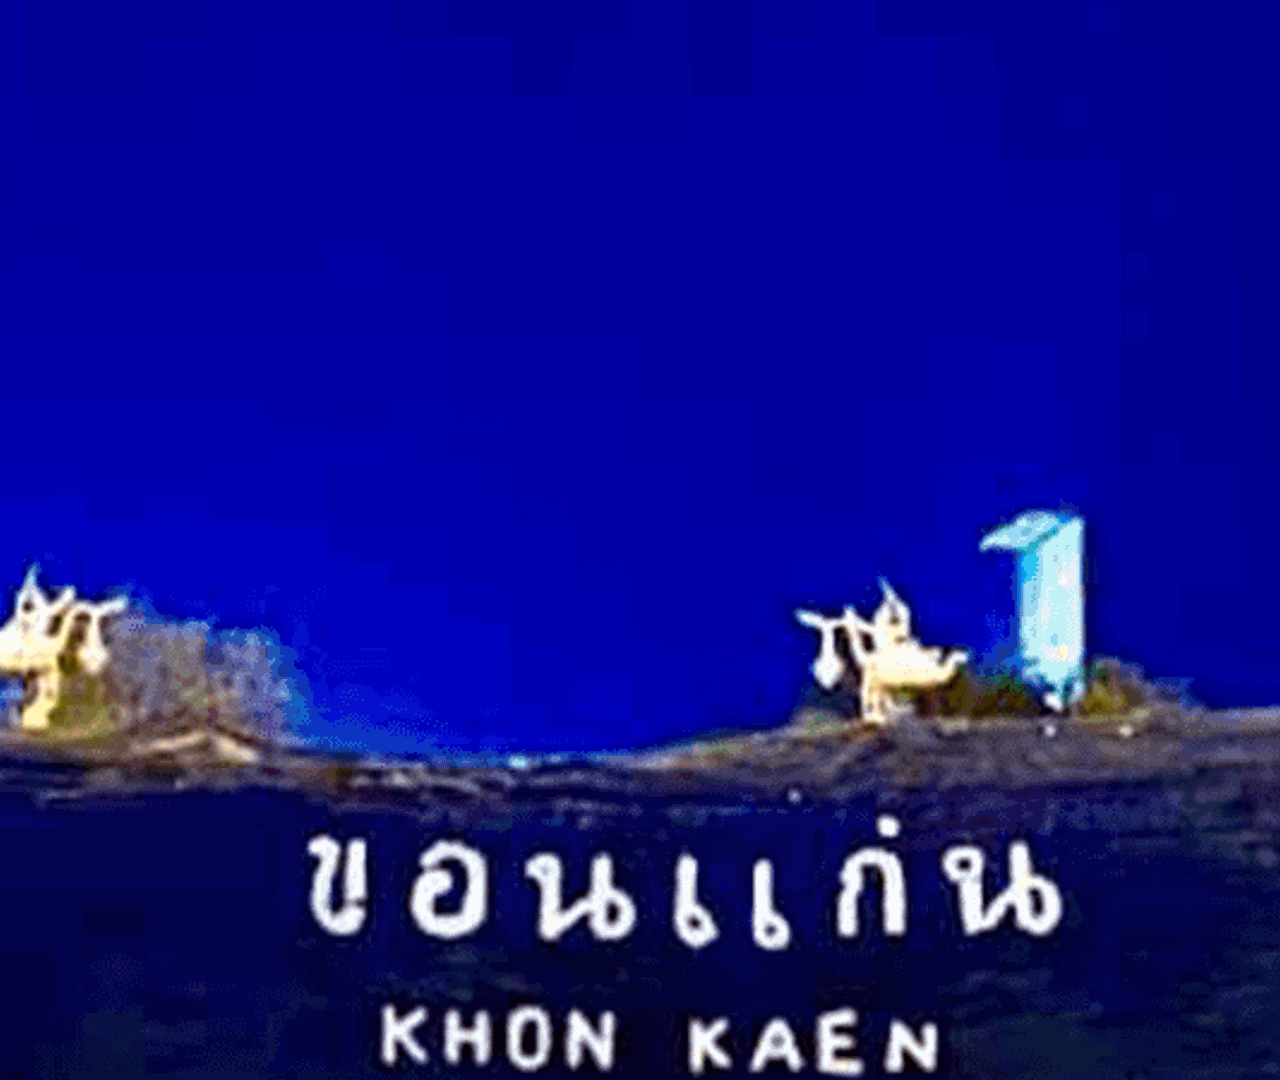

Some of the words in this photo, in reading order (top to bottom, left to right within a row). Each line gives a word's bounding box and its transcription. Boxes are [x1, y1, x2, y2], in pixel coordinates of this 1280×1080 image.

[307, 815, 1062, 950] ขอนแก่น
[381, 1005, 615, 1070] KHON
[688, 1008, 938, 1075] KAEN
